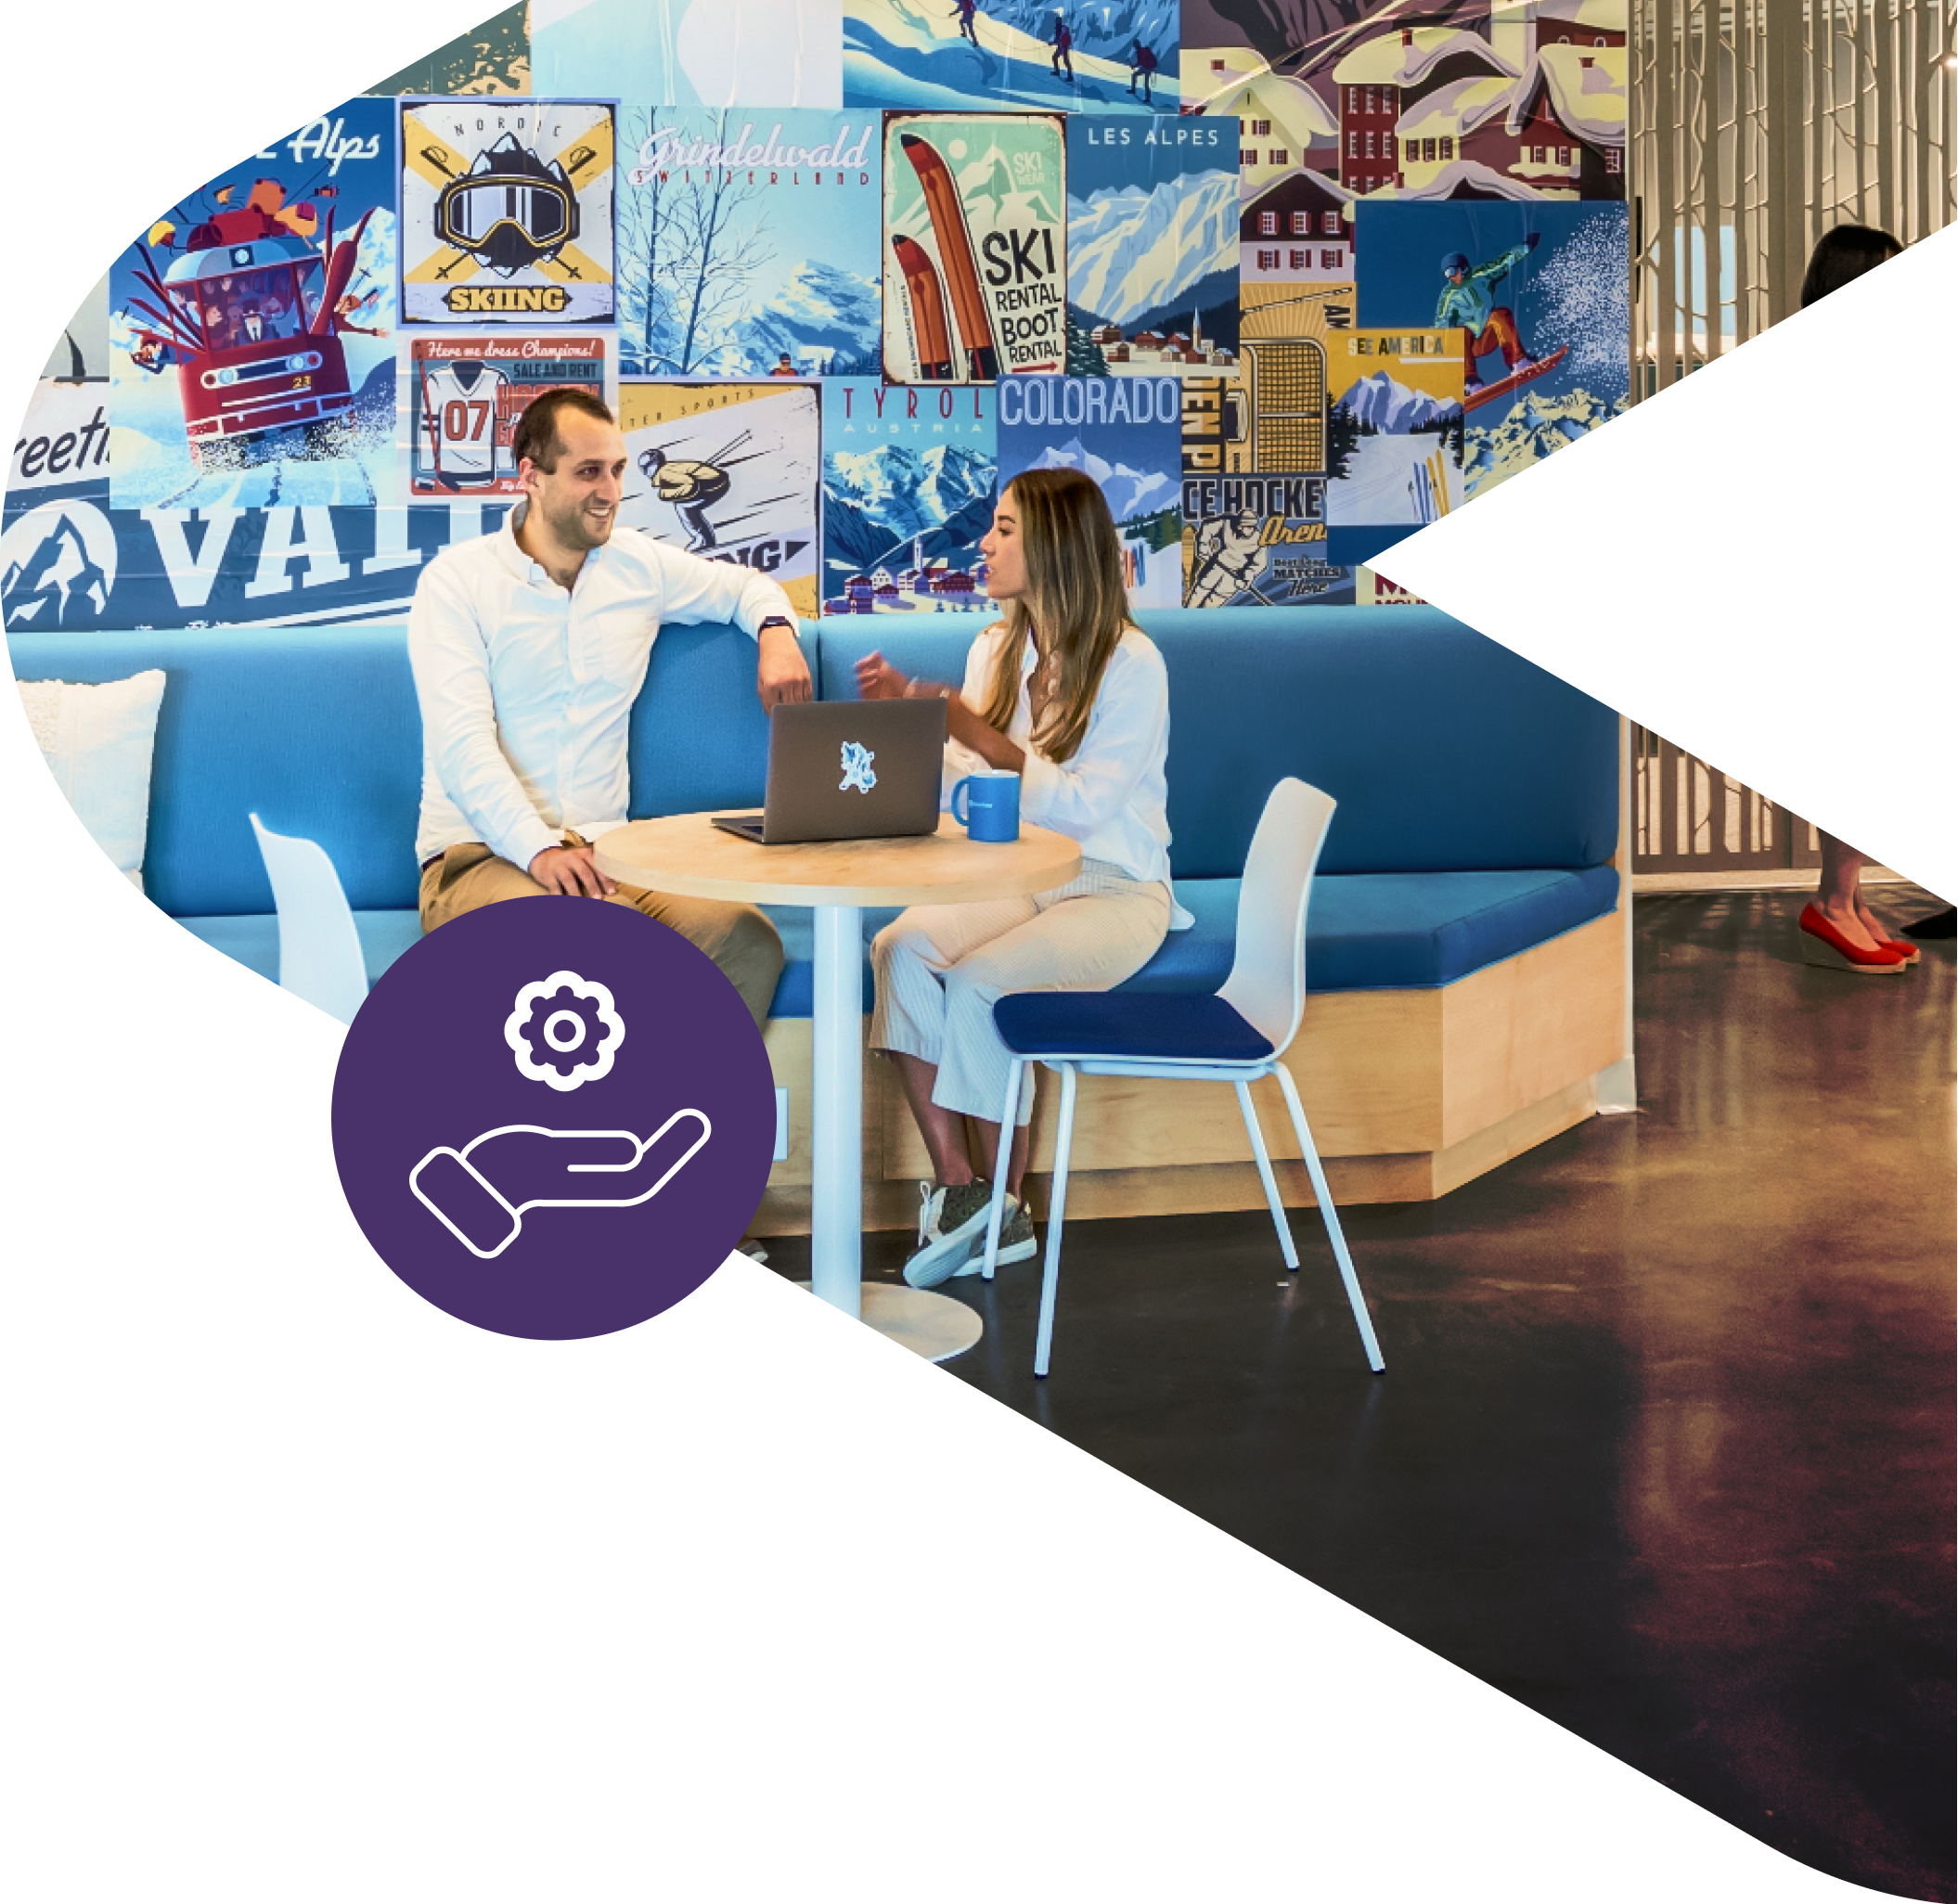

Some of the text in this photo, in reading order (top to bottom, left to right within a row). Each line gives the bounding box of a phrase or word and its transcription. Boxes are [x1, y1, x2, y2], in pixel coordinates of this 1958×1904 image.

[454, 117, 561, 136] NORDIC
[1088, 128, 1219, 147] LES ALPES
[287, 115, 380, 177] Alps
[627, 122, 873, 186] Grindelwald
[1012, 151, 1042, 174] SKI
[636, 170, 870, 185] SWITZERLAND
[982, 228, 1057, 287] SKI
[449, 286, 566, 312] SKIING
[995, 282, 1063, 313] RENTAL
[1000, 307, 1059, 346] BOOT
[426, 341, 462, 358] Here
[483, 340, 520, 357] dress
[521, 340, 596, 363] Champions!
[1009, 339, 1063, 364] RENTAL
[1347, 335, 1444, 356] SEE AMERICA
[513, 362, 598, 380] SALE AND RENT
[843, 388, 984, 419] TYROL
[999, 378, 1179, 426] COLORADO
[444, 400, 490, 441] 07
[620, 411, 663, 431] TER
[844, 423, 983, 433] AUSTRIA
[1221, 478, 1327, 520] HOCKE
[1259, 514, 1327, 547] Aren
